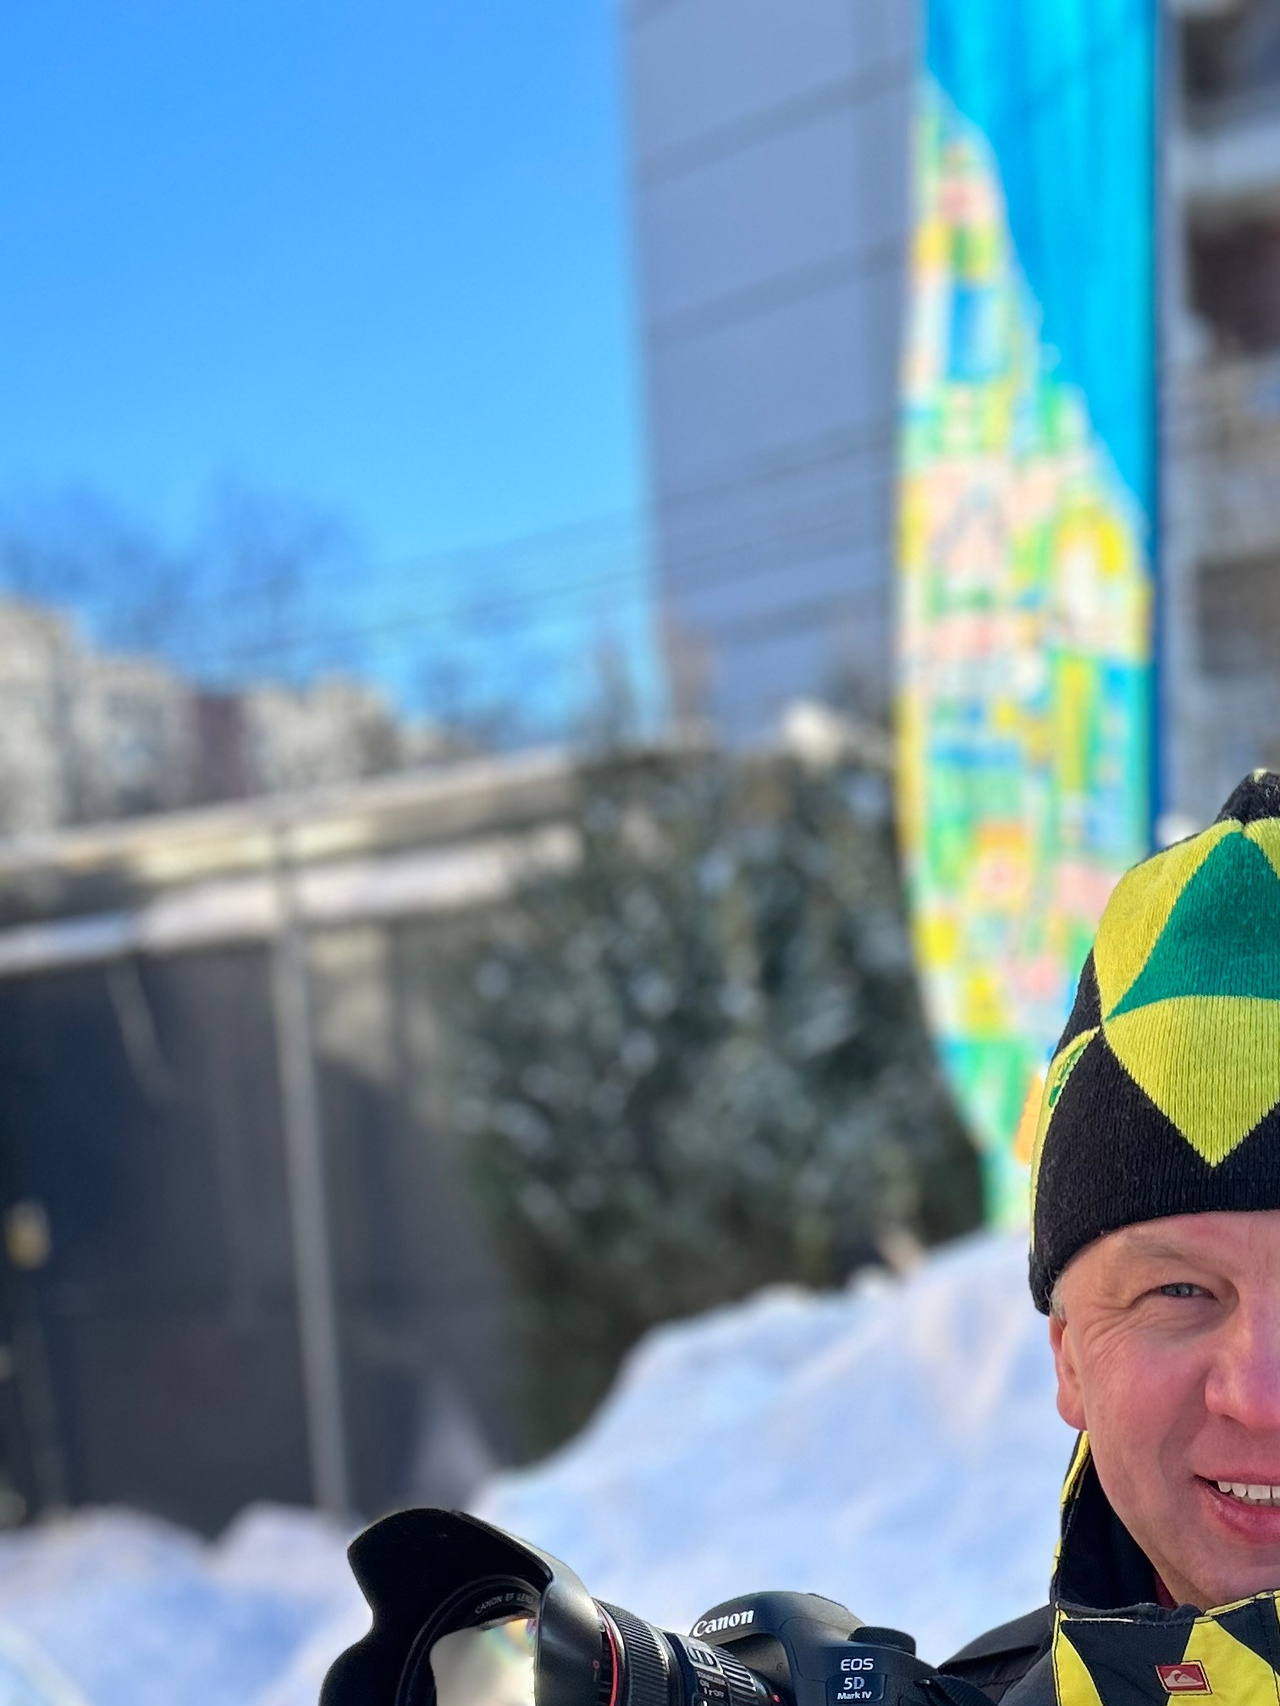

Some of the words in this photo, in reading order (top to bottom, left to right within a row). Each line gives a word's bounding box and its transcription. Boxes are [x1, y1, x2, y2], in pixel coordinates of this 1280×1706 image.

[692, 1610, 754, 1637] Canon
[840, 1658, 874, 1671] EOS
[843, 1677, 865, 1690] 5D
[837, 1692, 861, 1700] Mark
[861, 1691, 872, 1699] IV
